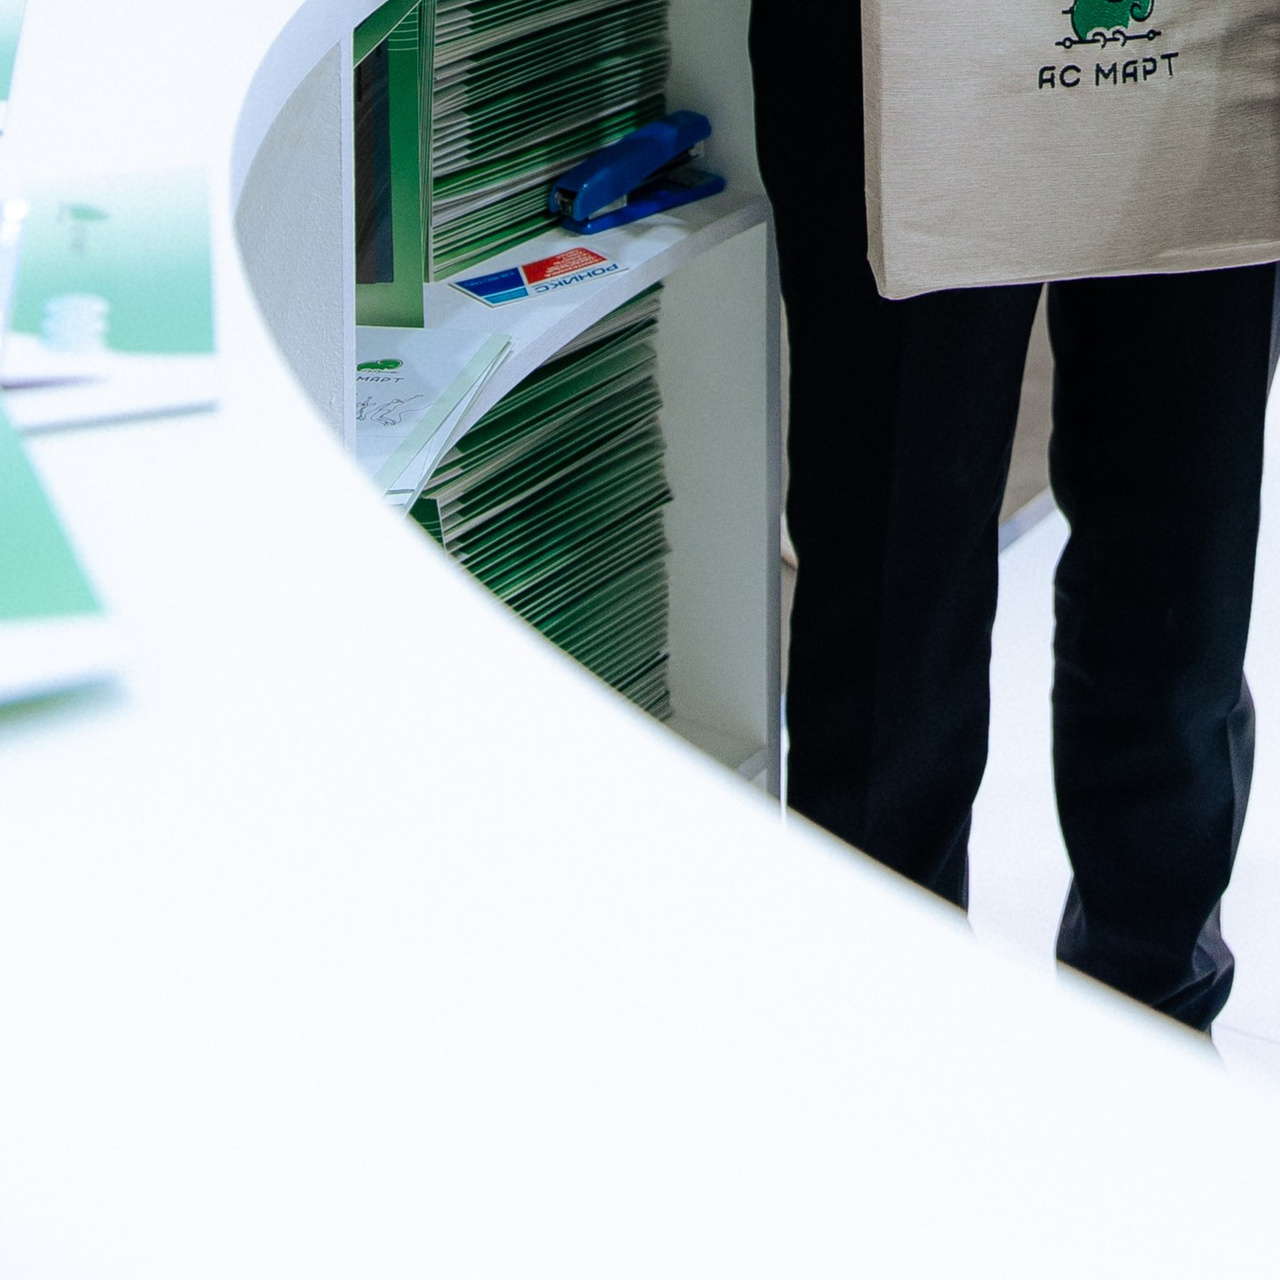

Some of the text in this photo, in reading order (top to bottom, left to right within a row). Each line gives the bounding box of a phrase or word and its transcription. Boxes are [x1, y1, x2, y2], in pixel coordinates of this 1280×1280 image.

[1038, 51, 1179, 90] АС МАРТ
[534, 263, 619, 294] РОНИКС
